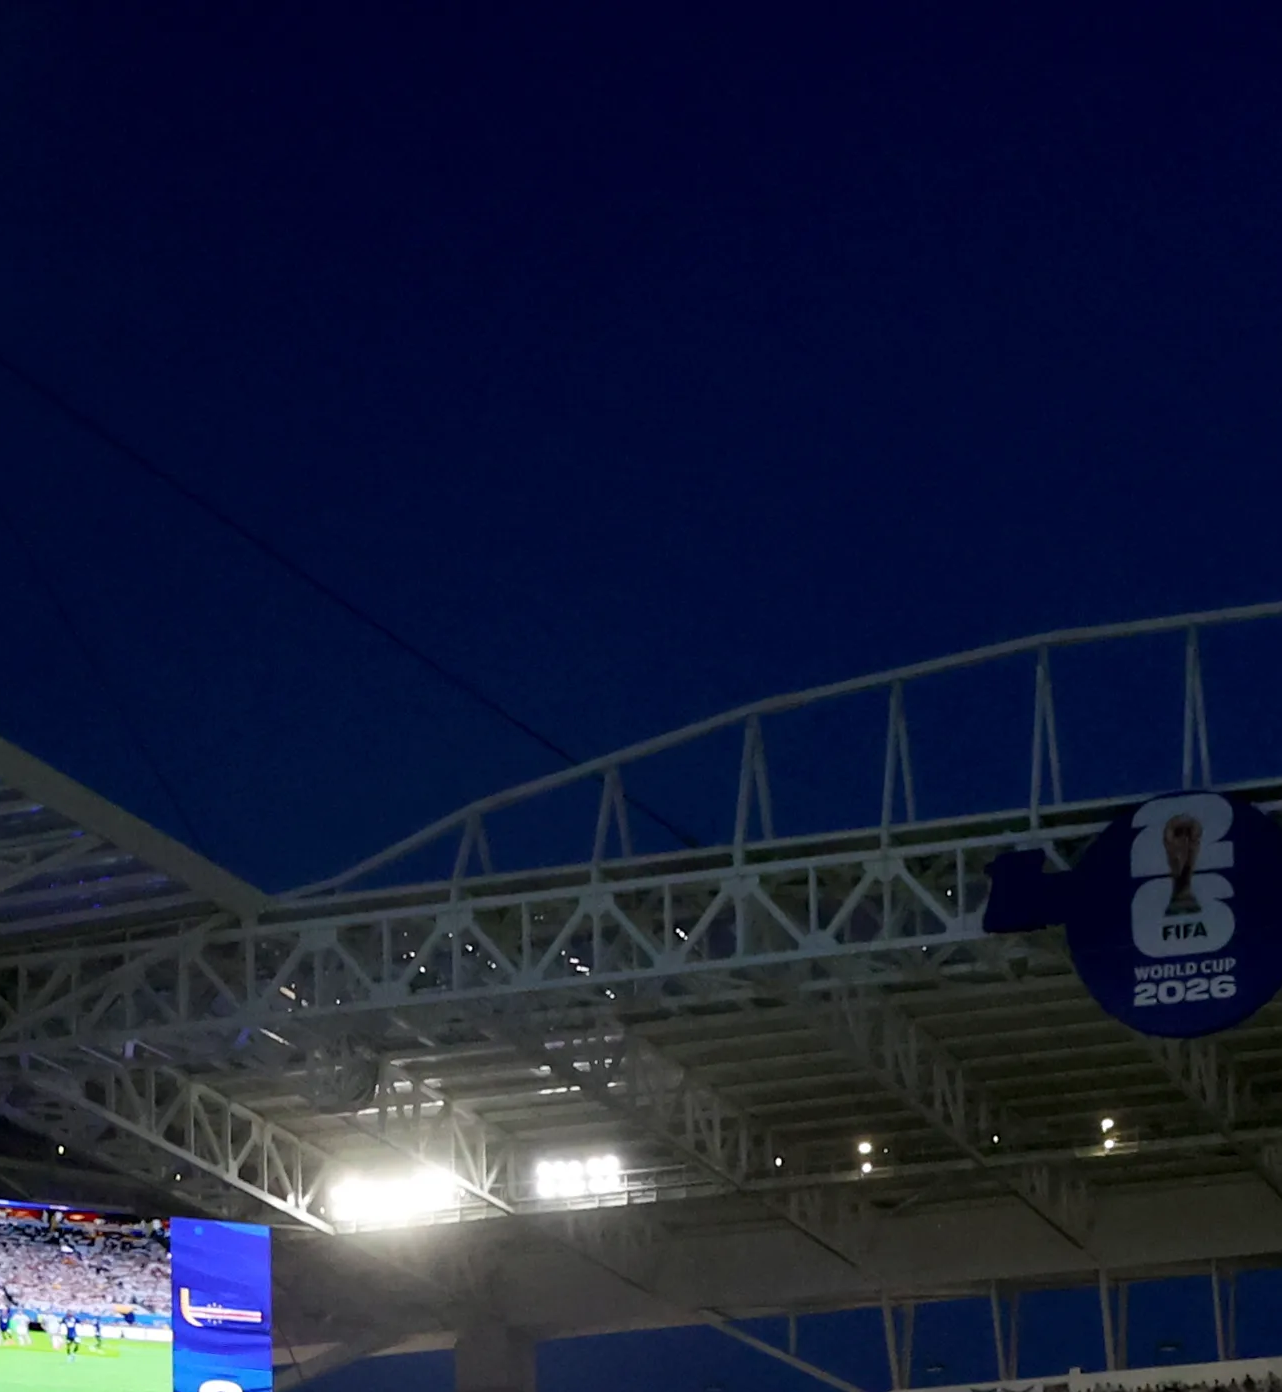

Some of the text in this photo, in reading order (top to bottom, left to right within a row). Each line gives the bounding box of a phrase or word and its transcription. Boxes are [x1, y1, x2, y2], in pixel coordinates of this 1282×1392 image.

[1162, 921, 1208, 942] FIFA
[1134, 957, 1237, 982] WORLD CUP
[1133, 975, 1237, 1007] 2026
